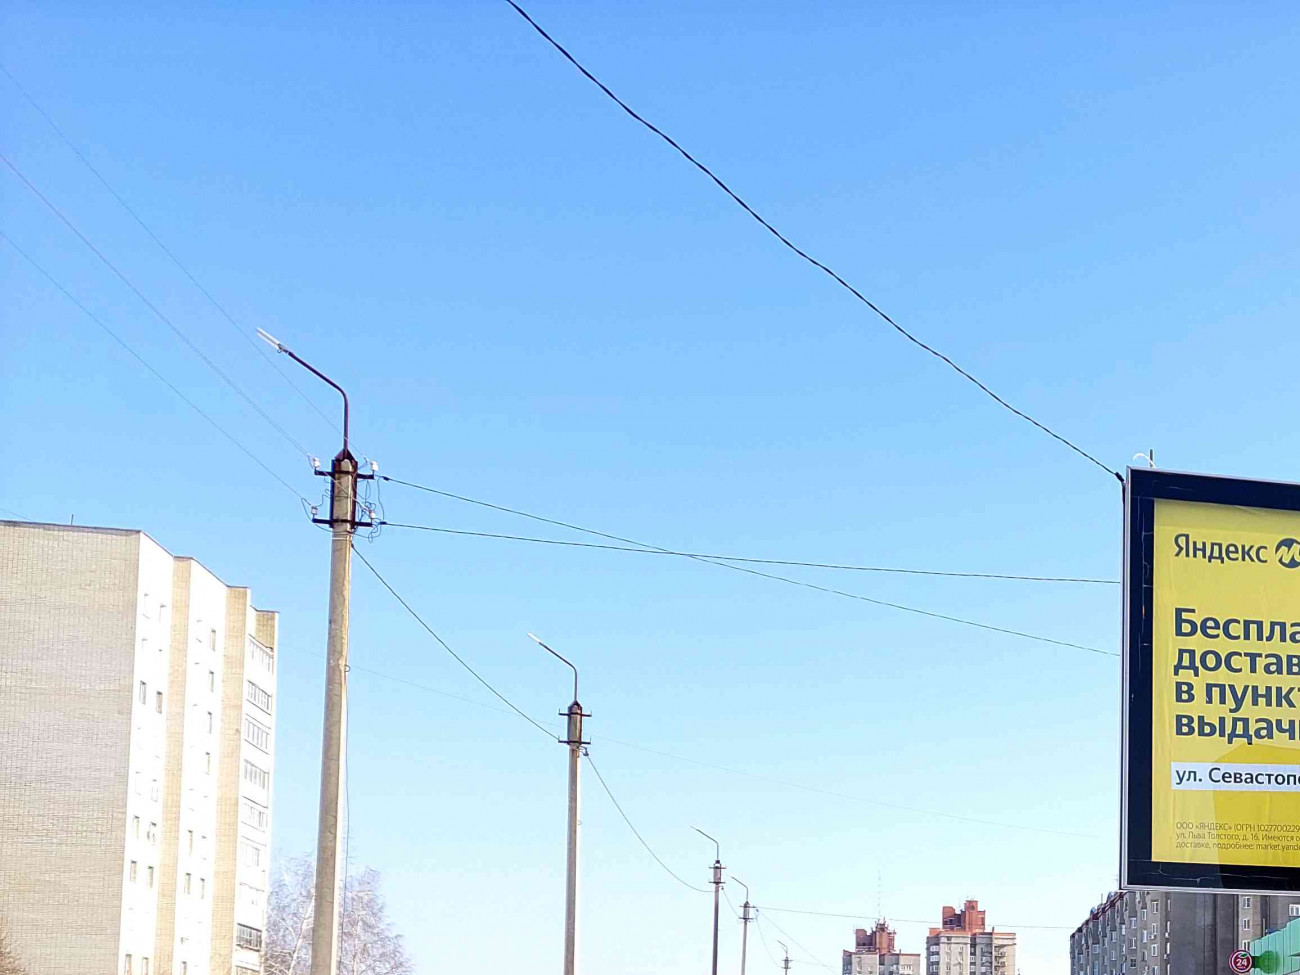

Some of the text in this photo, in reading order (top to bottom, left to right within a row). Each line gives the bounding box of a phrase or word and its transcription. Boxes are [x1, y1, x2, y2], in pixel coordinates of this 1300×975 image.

[1173, 533, 1268, 564] Яндекс
[1175, 681, 1195, 703] в
[1175, 768, 1203, 785] ул.
[1176, 821, 1194, 830] ООО
[1233, 823, 1256, 833] (ОГРН
[1188, 831, 1206, 840] Льва
[1207, 832, 1241, 842] Толстого,
[1262, 833, 1295, 842] Имеются
[1236, 958, 1248, 967] 24
